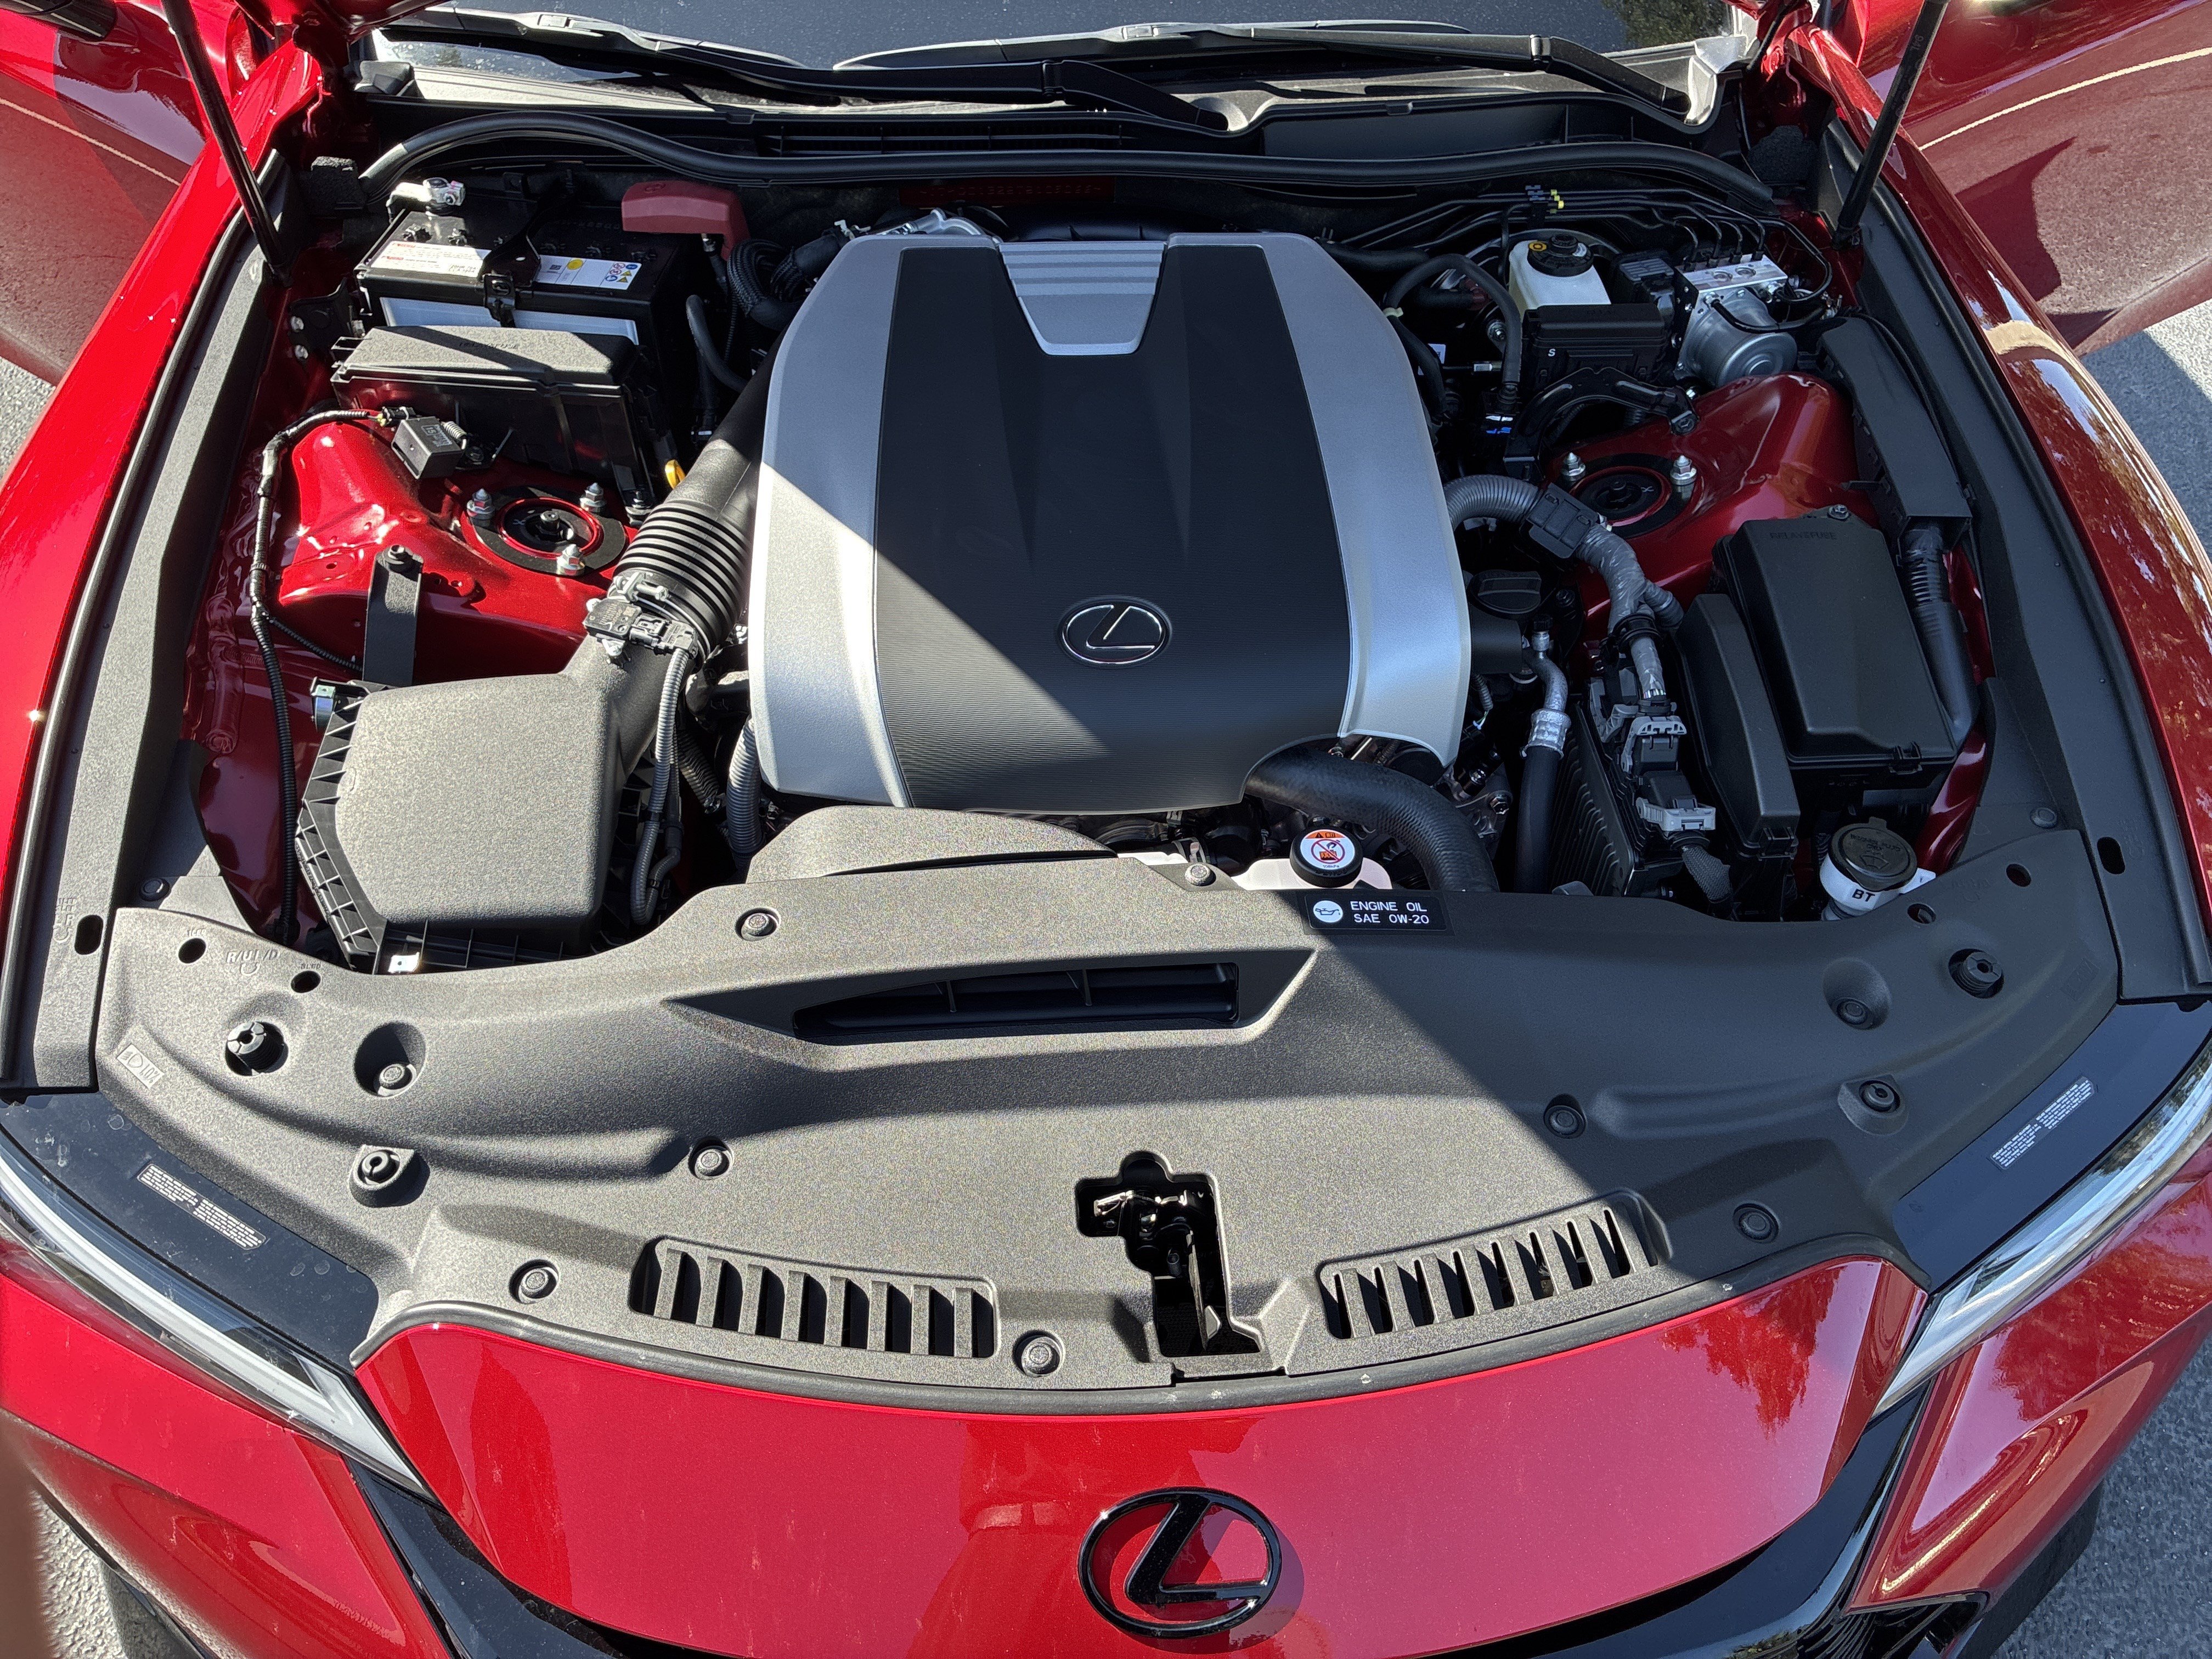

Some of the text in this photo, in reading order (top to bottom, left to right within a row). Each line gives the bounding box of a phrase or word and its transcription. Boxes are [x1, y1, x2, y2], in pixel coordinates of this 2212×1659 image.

[1548, 348, 1556, 357] S
[1852, 889, 1876, 902] BT
[1350, 901, 1427, 912] ENGINE OIL
[1353, 913, 1430, 924] SAE 0W-20
